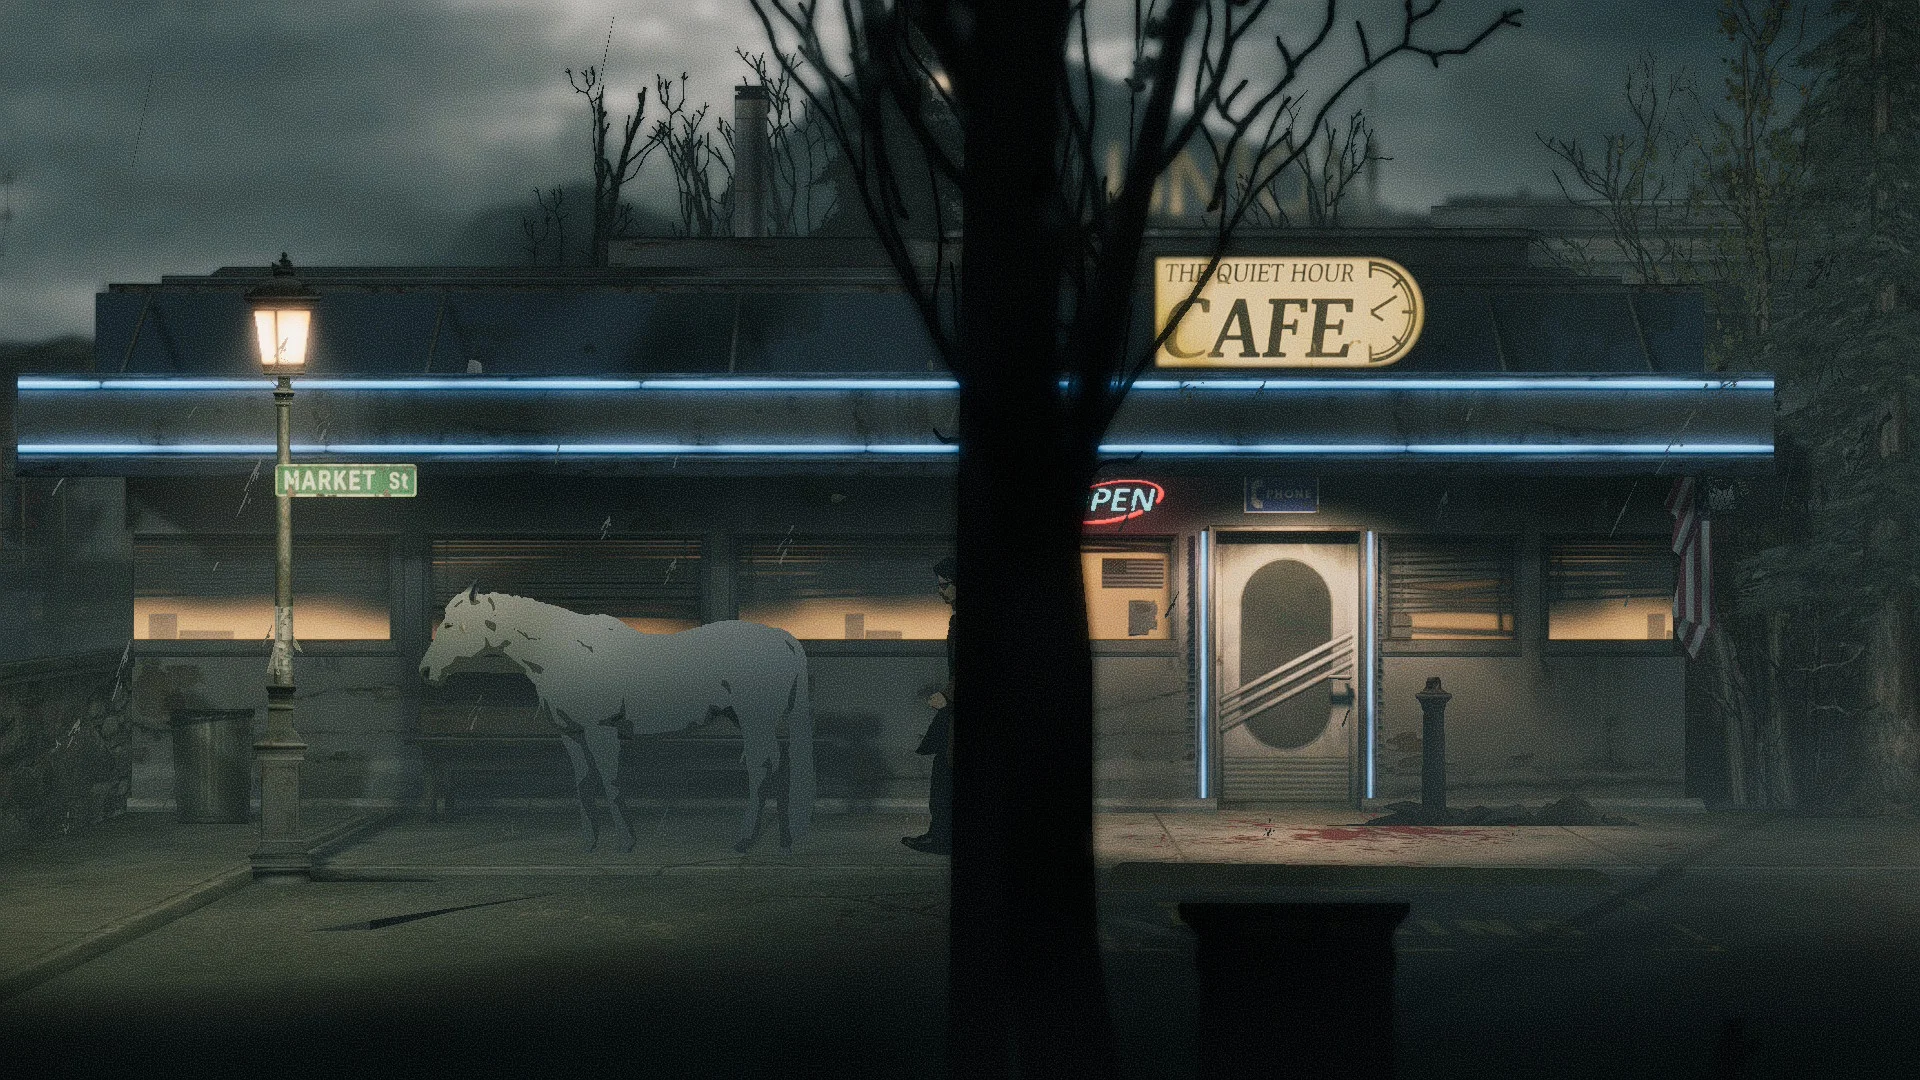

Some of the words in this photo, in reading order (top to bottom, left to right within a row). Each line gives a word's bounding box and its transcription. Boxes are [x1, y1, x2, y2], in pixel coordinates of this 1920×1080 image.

[1217, 263, 1284, 284] QUIET
[1291, 263, 1354, 282] HOUR
[1164, 298, 1354, 358] CAFE
[284, 469, 376, 491] MARKET
[389, 471, 409, 490] St
[1087, 487, 1156, 512] PEN
[1266, 488, 1312, 500] PHONE
